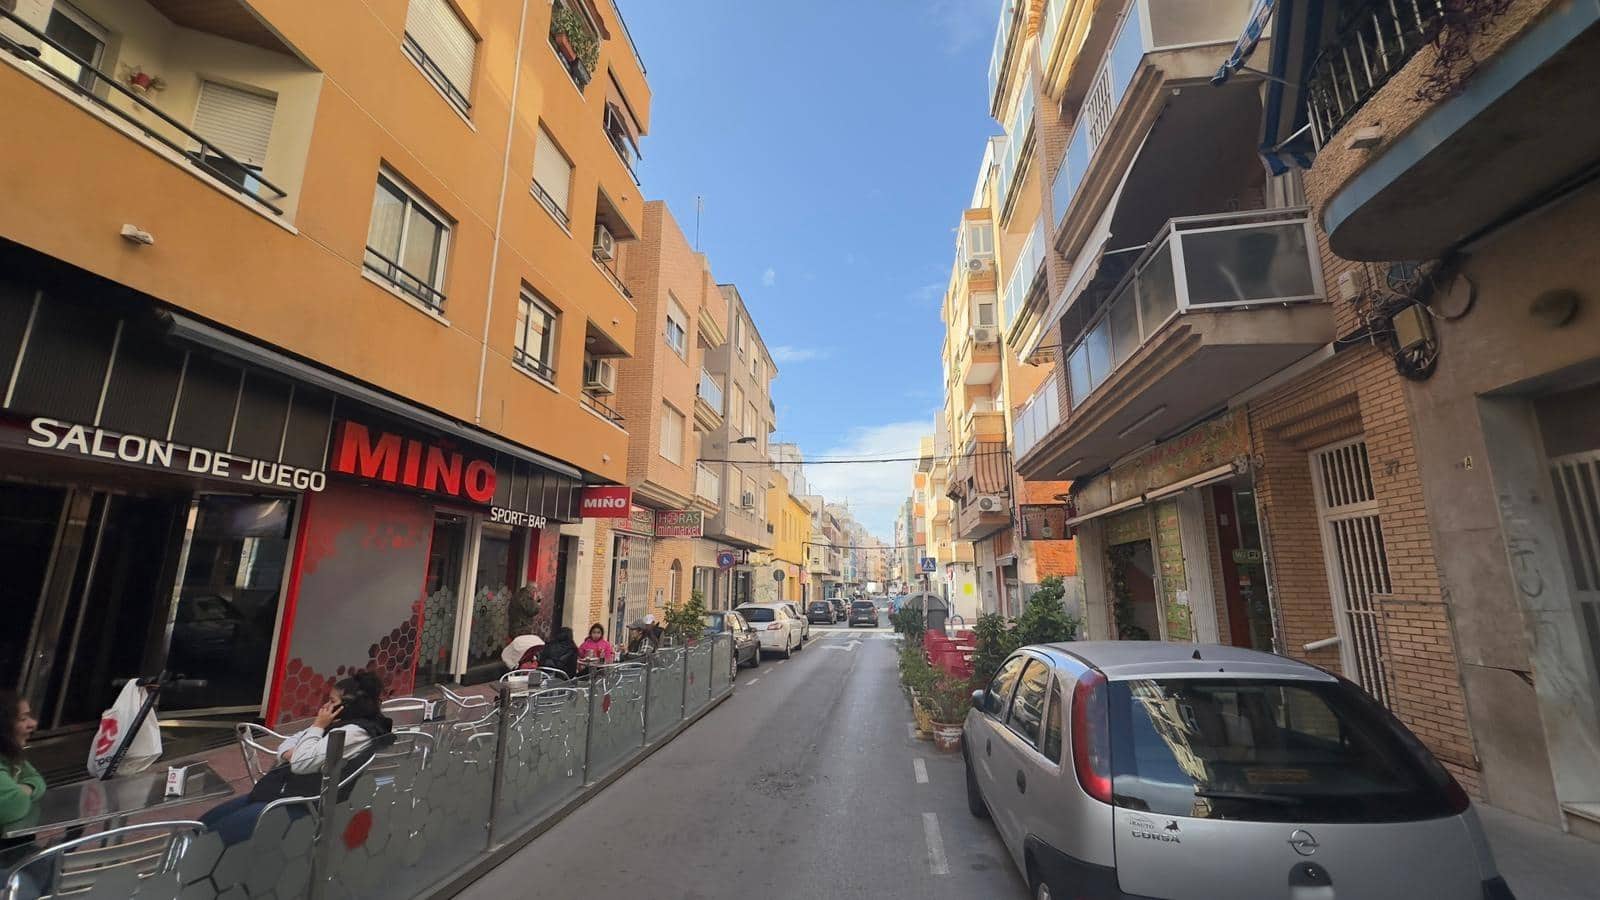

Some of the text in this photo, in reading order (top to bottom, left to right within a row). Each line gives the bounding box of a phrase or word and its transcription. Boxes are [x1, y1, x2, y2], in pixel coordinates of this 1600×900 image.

[27, 417, 326, 492] SALON DE JUEGO
[584, 496, 626, 508] MIÑO
[490, 507, 547, 529] SPORT-BAR
[659, 512, 700, 525] HORAS
[1131, 831, 1181, 844] CORSA
